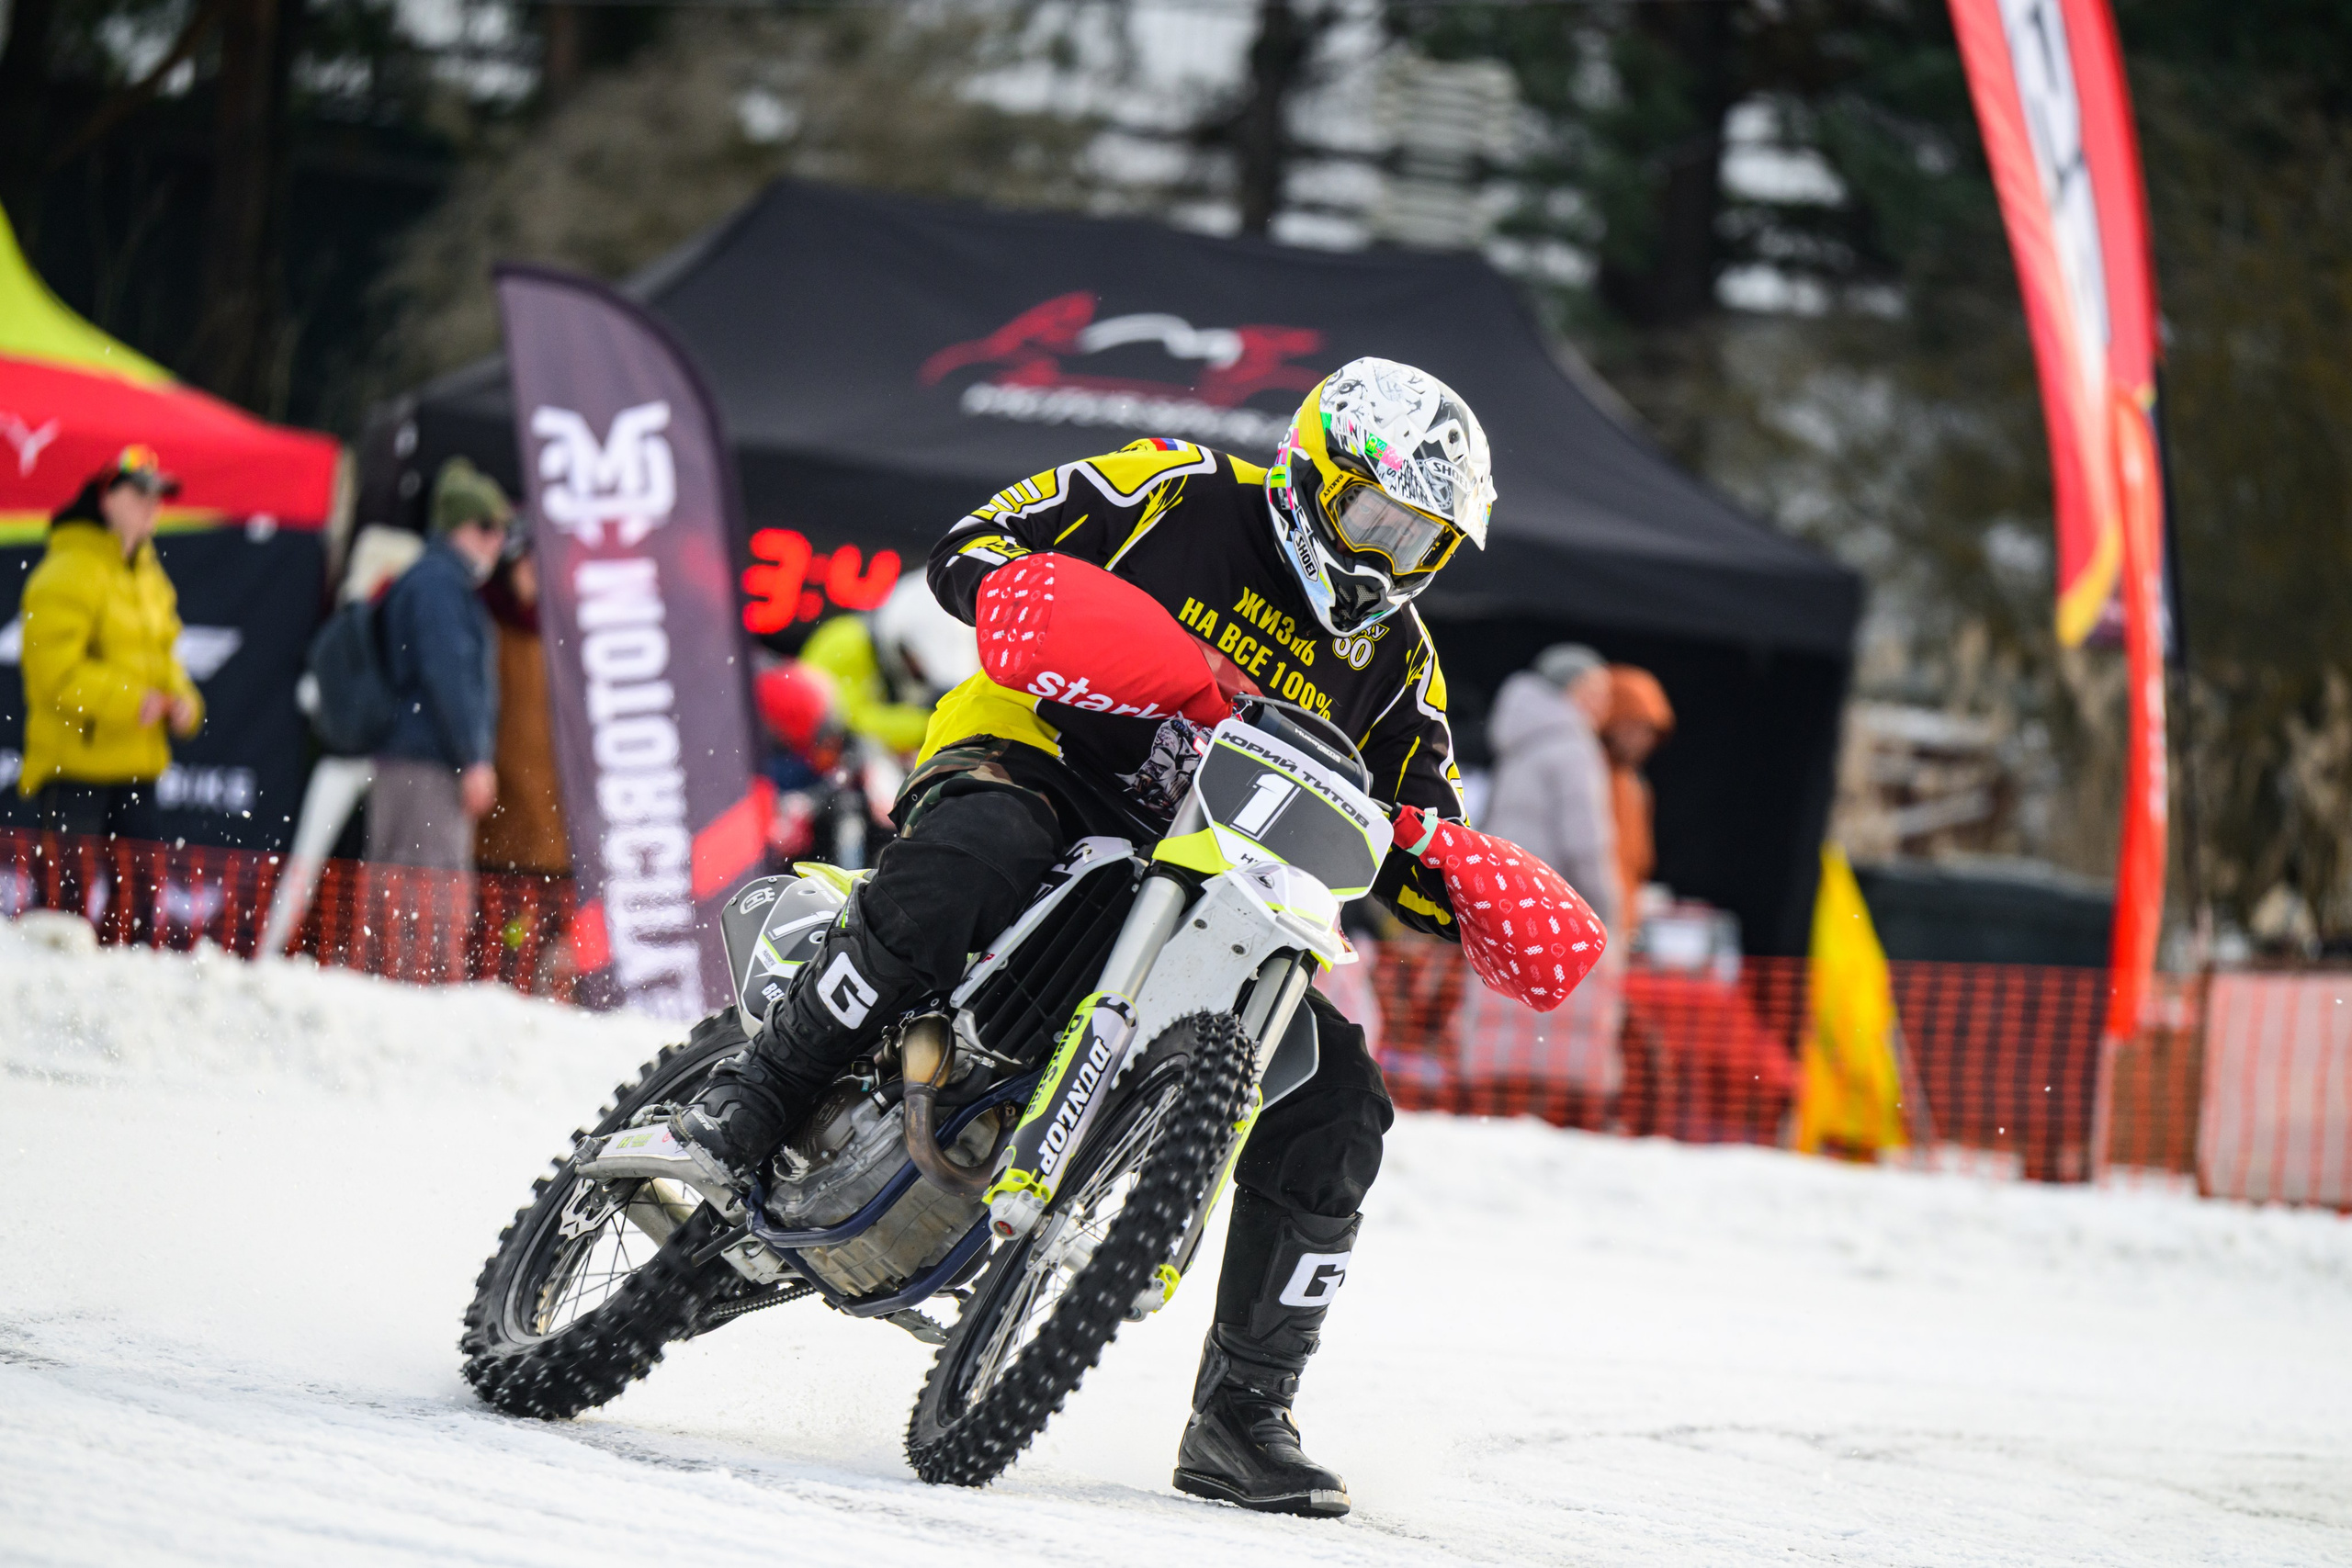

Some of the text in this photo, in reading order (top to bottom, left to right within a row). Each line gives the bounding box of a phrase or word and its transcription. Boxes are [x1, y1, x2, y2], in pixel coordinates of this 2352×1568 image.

[1323, 473, 1344, 498] OAKLEY
[1432, 462, 1469, 489] SHOEI
[1295, 536, 1317, 577] SHOEI
[1178, 597, 1333, 721] НА ВСЕ 100%
[1220, 731, 1371, 829] ЮРИЙ ТИТОВ
[1229, 773, 1302, 841] 1
[1037, 1035, 1114, 1177] DUNLOP
